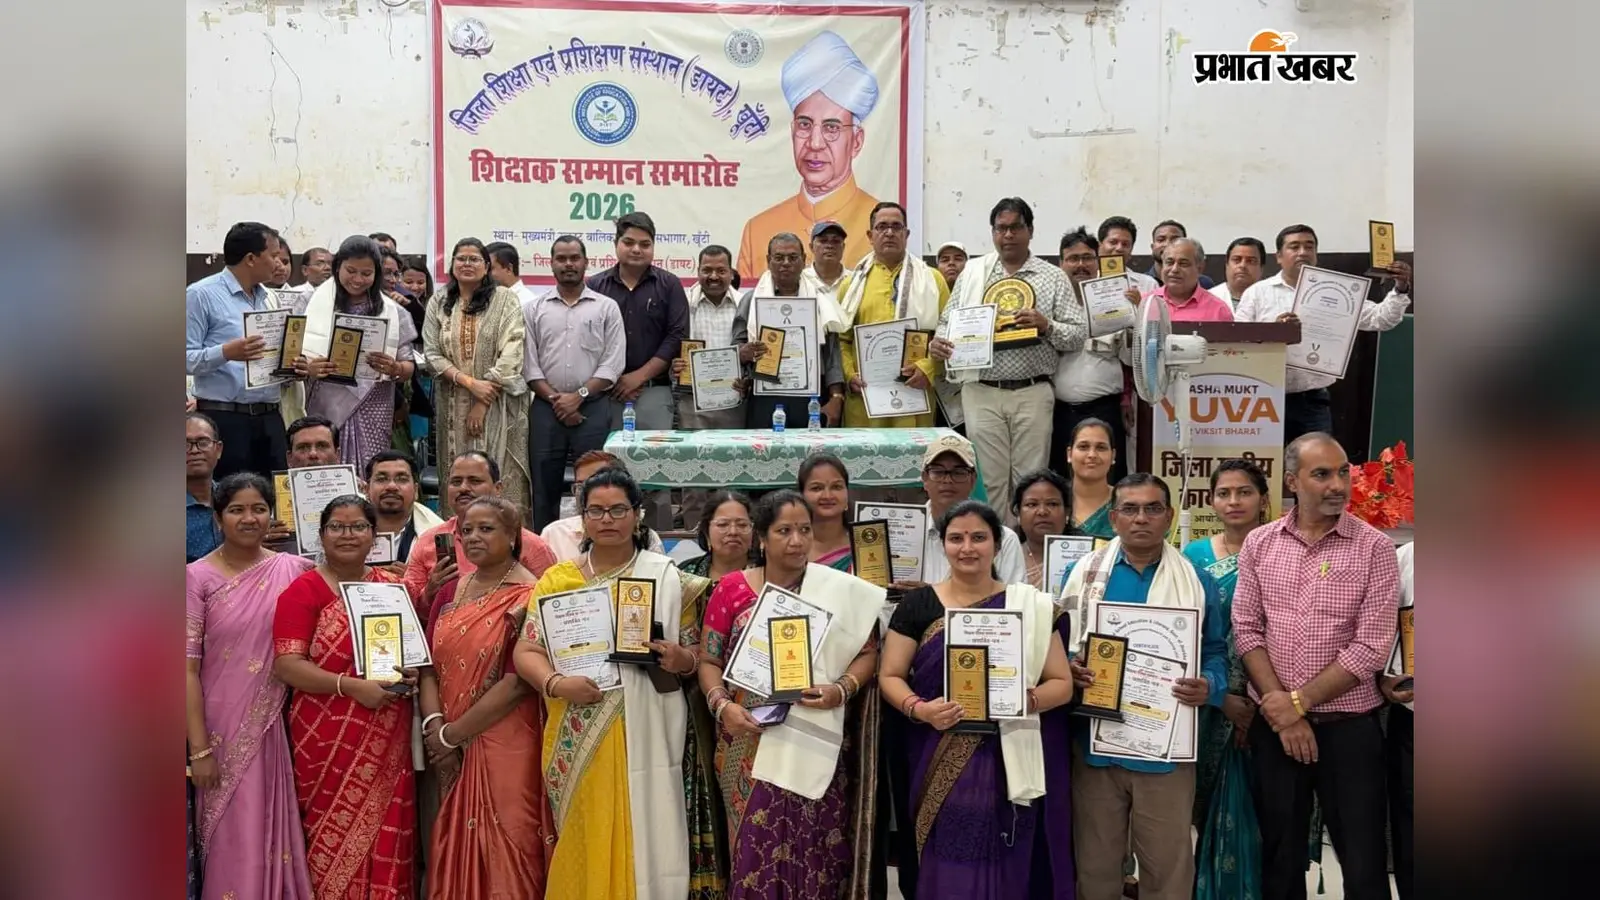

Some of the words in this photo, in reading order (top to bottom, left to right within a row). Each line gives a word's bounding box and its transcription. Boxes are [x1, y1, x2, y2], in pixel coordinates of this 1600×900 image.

[449, 88, 498, 133] जिला
[483, 61, 534, 101] शिक्षा
[530, 45, 558, 83] एवं
[558, 37, 626, 71] प्रशिक्षण
[629, 41, 684, 80] संस्थान
[468, 148, 558, 184] शिक्षक
[560, 158, 646, 186] सम्मान
[647, 153, 741, 188] समारोह
[569, 191, 636, 221] 2026
[521, 228, 556, 245] मुख्यमंत्री
[533, 252, 552, 268] जिल
[1189, 384, 1221, 394] ASHA
[1224, 385, 1259, 394] MUKT
[1195, 427, 1223, 436] VIKSIT
[1225, 427, 1262, 436] BHARAT
[1161, 450, 1213, 478] जिला
